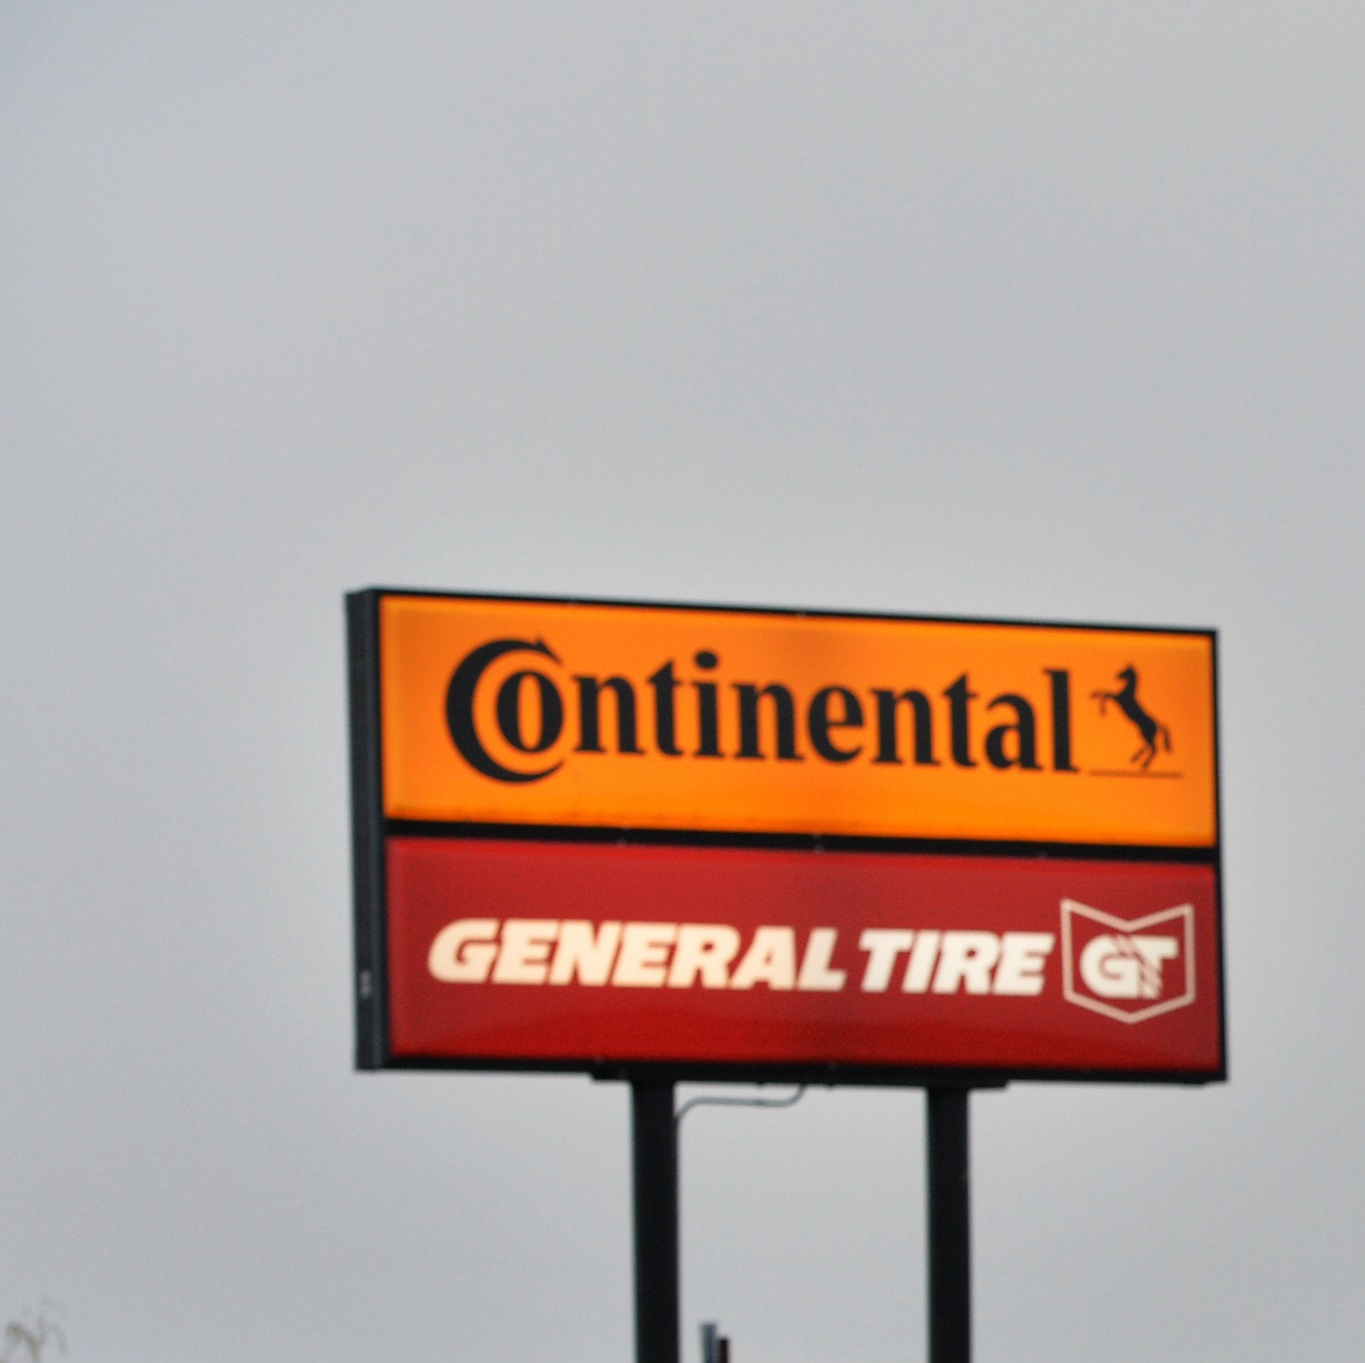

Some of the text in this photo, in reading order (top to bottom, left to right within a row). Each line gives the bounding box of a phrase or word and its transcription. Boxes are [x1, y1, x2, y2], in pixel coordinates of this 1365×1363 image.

[445, 636, 1079, 783] Continental
[429, 918, 1055, 996] GENERAL TIRE
[1079, 935, 1179, 1000] GT
